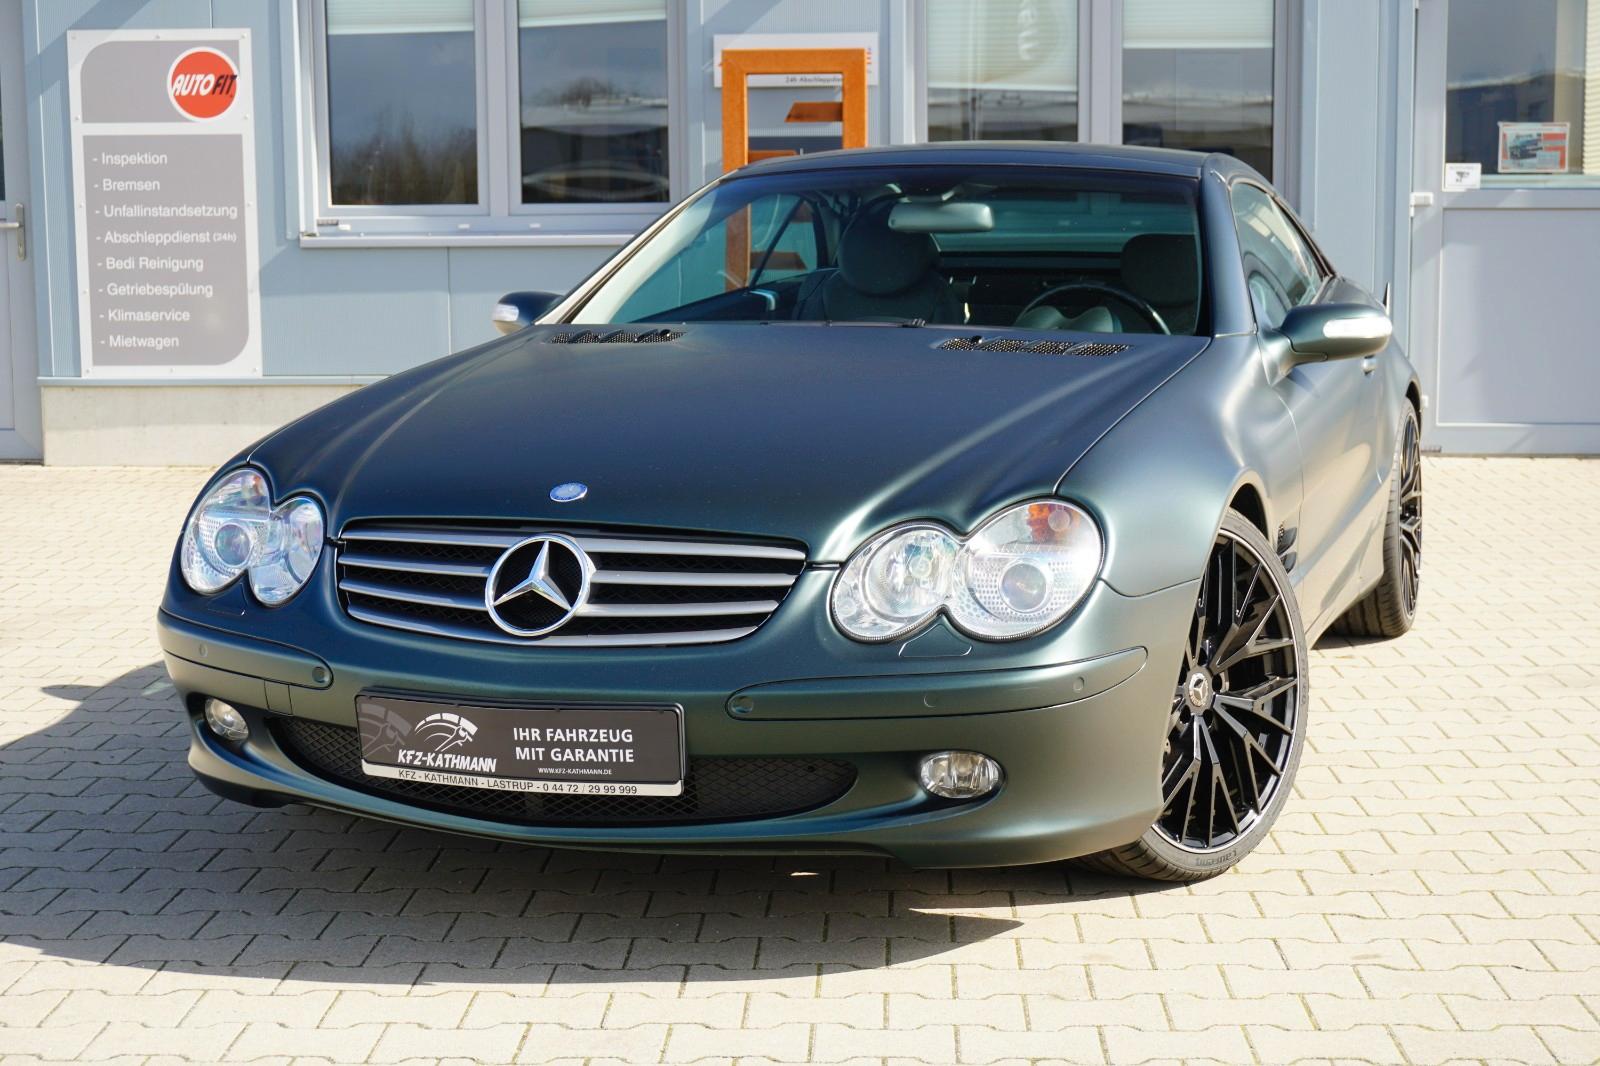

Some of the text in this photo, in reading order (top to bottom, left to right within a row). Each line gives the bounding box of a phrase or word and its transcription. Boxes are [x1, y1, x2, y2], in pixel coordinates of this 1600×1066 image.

[102, 152, 168, 167] Inspektion
[103, 179, 160, 191] Bremsen
[104, 205, 238, 219] Unfallinstandsetzung
[104, 231, 210, 246] Abschleppdienst
[213, 232, 237, 243] (24h)
[106, 257, 135, 270] Bedi
[139, 256, 204, 272] Reinigung
[107, 282, 214, 298] Getriebespülung
[108, 309, 190, 322] Klimaservice
[109, 335, 180, 350] Mietwagen
[513, 727, 633, 743] IHR FAHRZEUG
[397, 749, 497, 773] KFZ-KATHMANN
[515, 747, 634, 763] MIT GARANTIE
[538, 767, 613, 775] WWW.KFZ-KATHMANN.DE
[398, 769, 417, 780] KFZ
[424, 772, 478, 787] KATHMANN
[487, 779, 534, 791] LASTRUP
[543, 783, 549, 791] 0
[552, 784, 564, 792] 44
[567, 784, 579, 793] 72
[588, 784, 601, 793] 29
[603, 785, 616, 794] 99
[618, 785, 638, 795] 999
